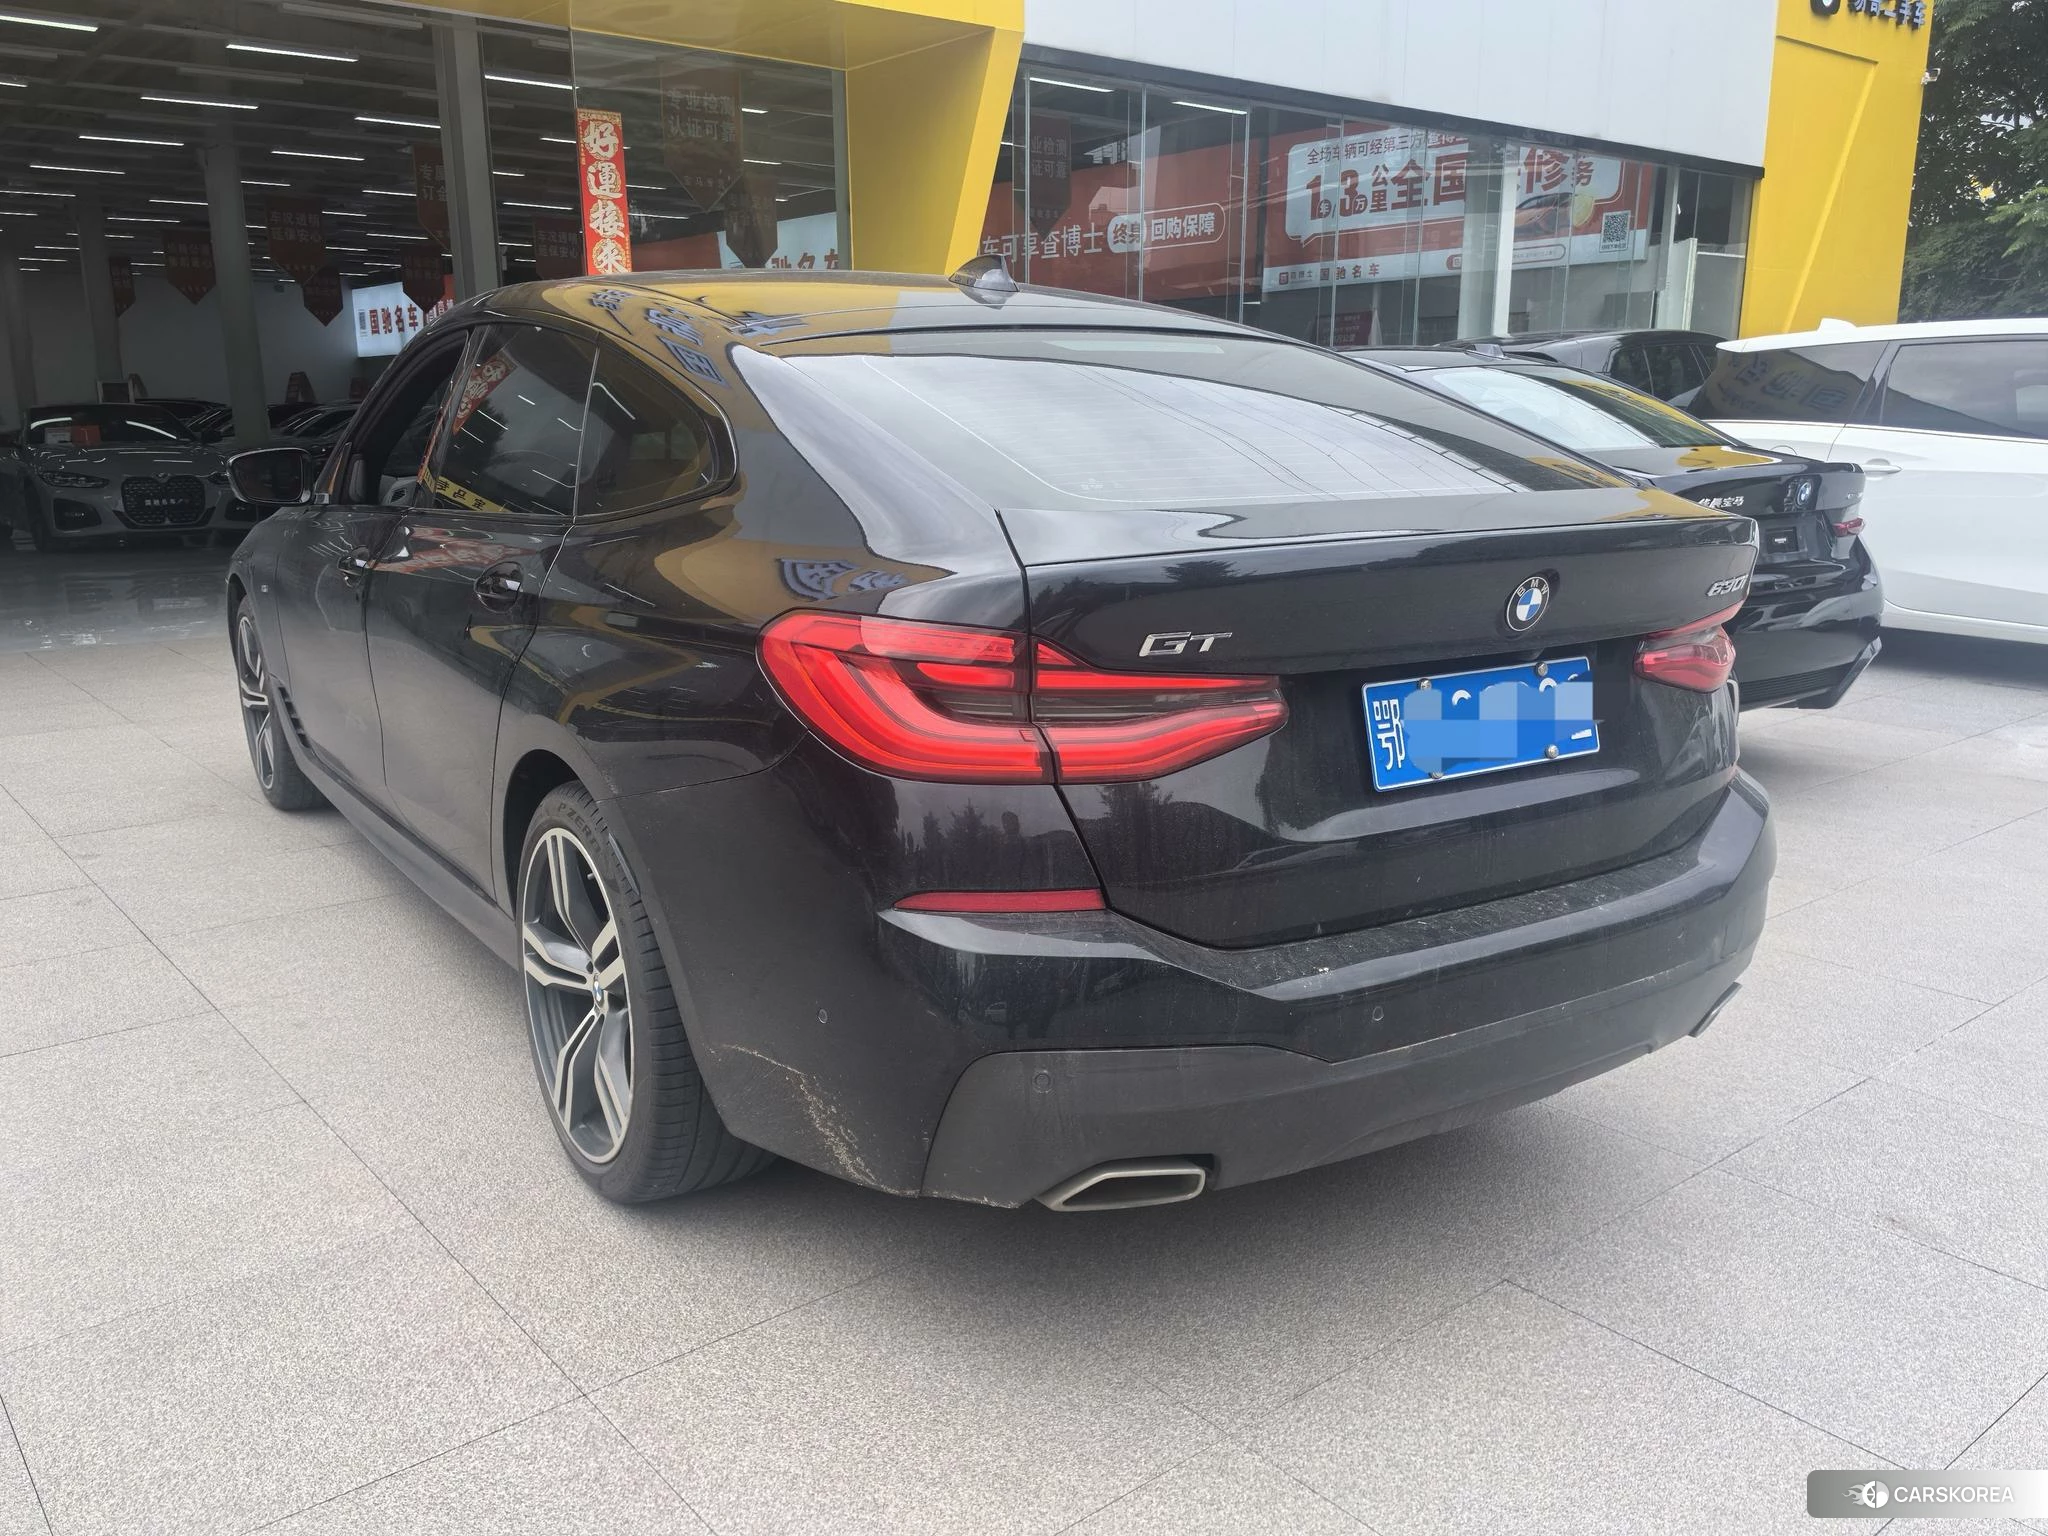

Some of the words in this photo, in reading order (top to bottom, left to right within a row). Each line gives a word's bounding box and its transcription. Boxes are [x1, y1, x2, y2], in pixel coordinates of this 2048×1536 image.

[1029, 135, 1067, 160] 业检测
[1029, 159, 1067, 178] 证可靠
[1139, 632, 1232, 657] GT
